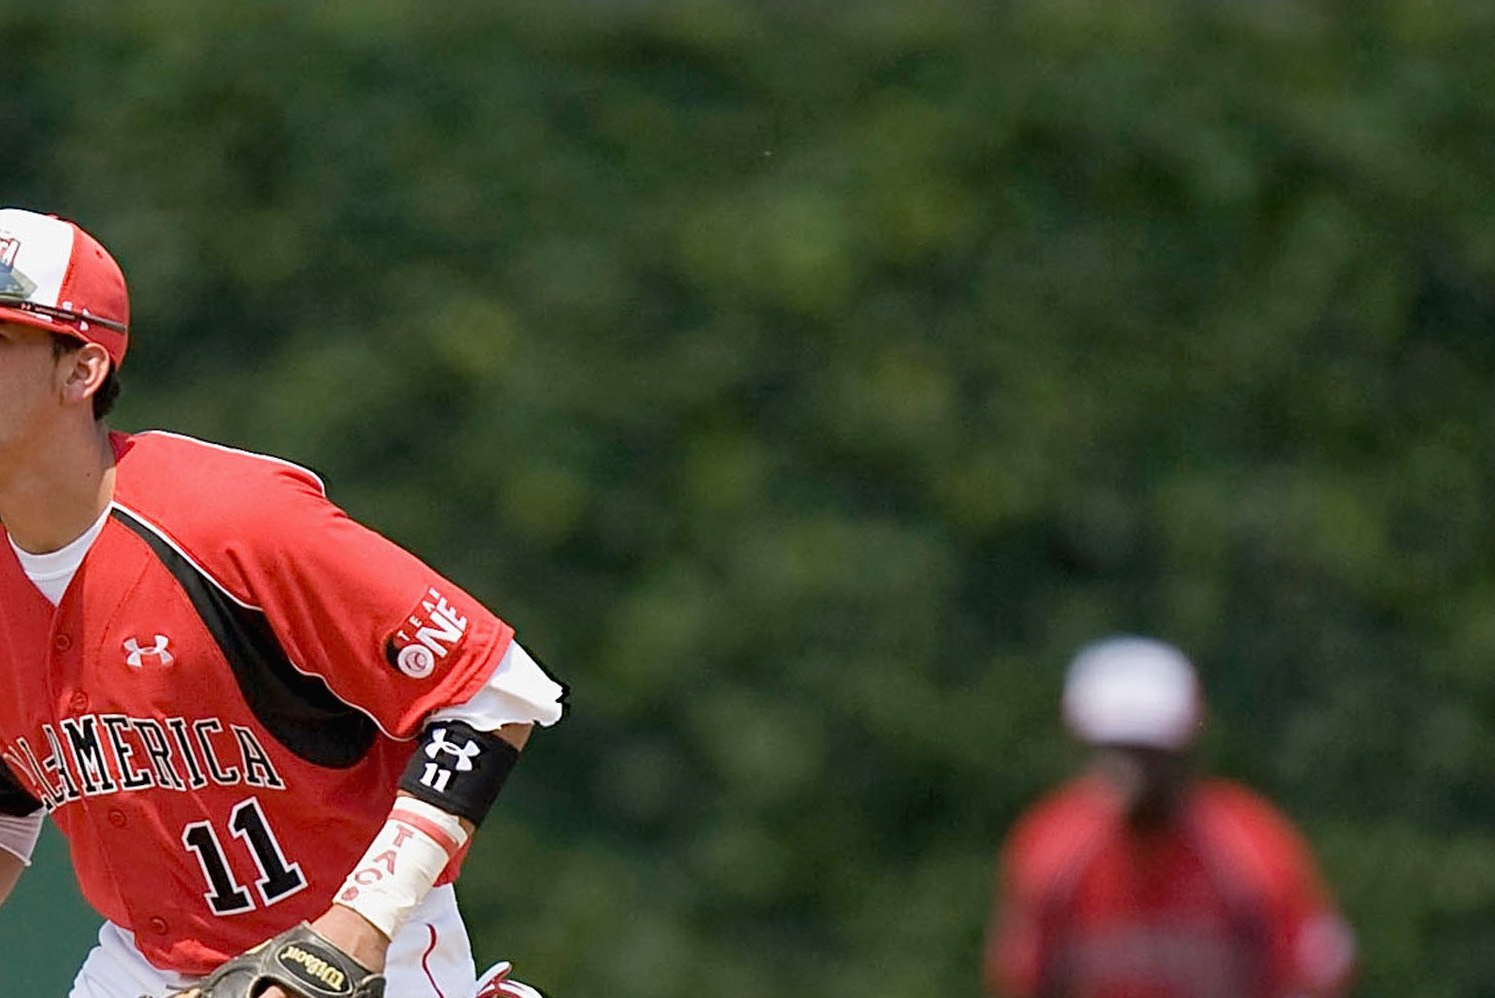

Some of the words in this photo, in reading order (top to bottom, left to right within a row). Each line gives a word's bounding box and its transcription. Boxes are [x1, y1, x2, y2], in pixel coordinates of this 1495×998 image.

[397, 596, 468, 679] ONE
[420, 762, 452, 793] 11
[182, 796, 308, 916] 11
[280, 945, 345, 992] Wilson
